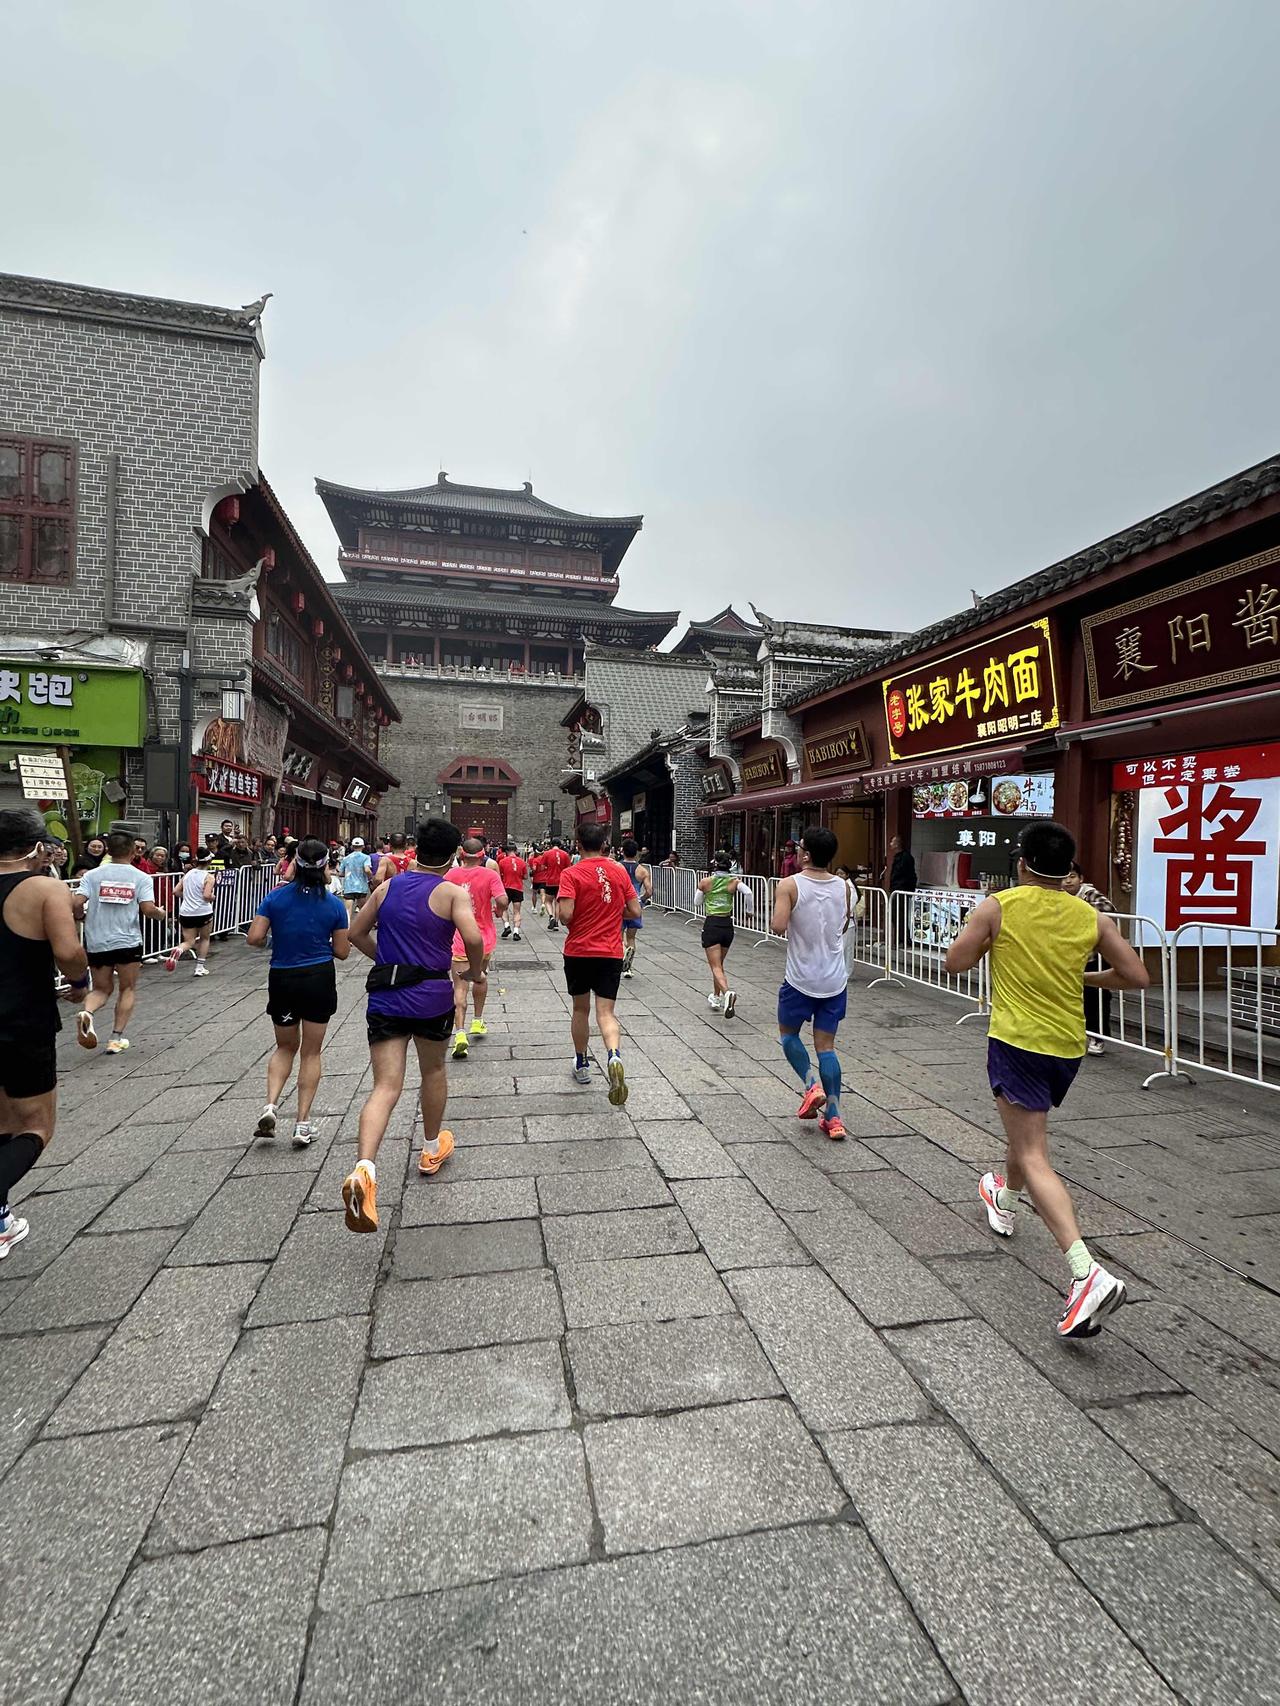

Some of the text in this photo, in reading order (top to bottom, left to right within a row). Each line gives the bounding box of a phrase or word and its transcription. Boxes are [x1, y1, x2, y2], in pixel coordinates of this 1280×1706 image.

[1113, 583, 1280, 681] 襄阳酱
[906, 645, 1040, 732] 张家牛肉面
[888, 694, 904, 734] 老字号
[977, 710, 1042, 738] 襄阳昭明二店
[808, 738, 851, 764] BABIBOY
[745, 762, 770, 780] BABIBOY
[1125, 756, 1197, 775] 可以不买
[1141, 764, 1241, 786] 但一定要尝
[1153, 782, 1267, 932] 酱
